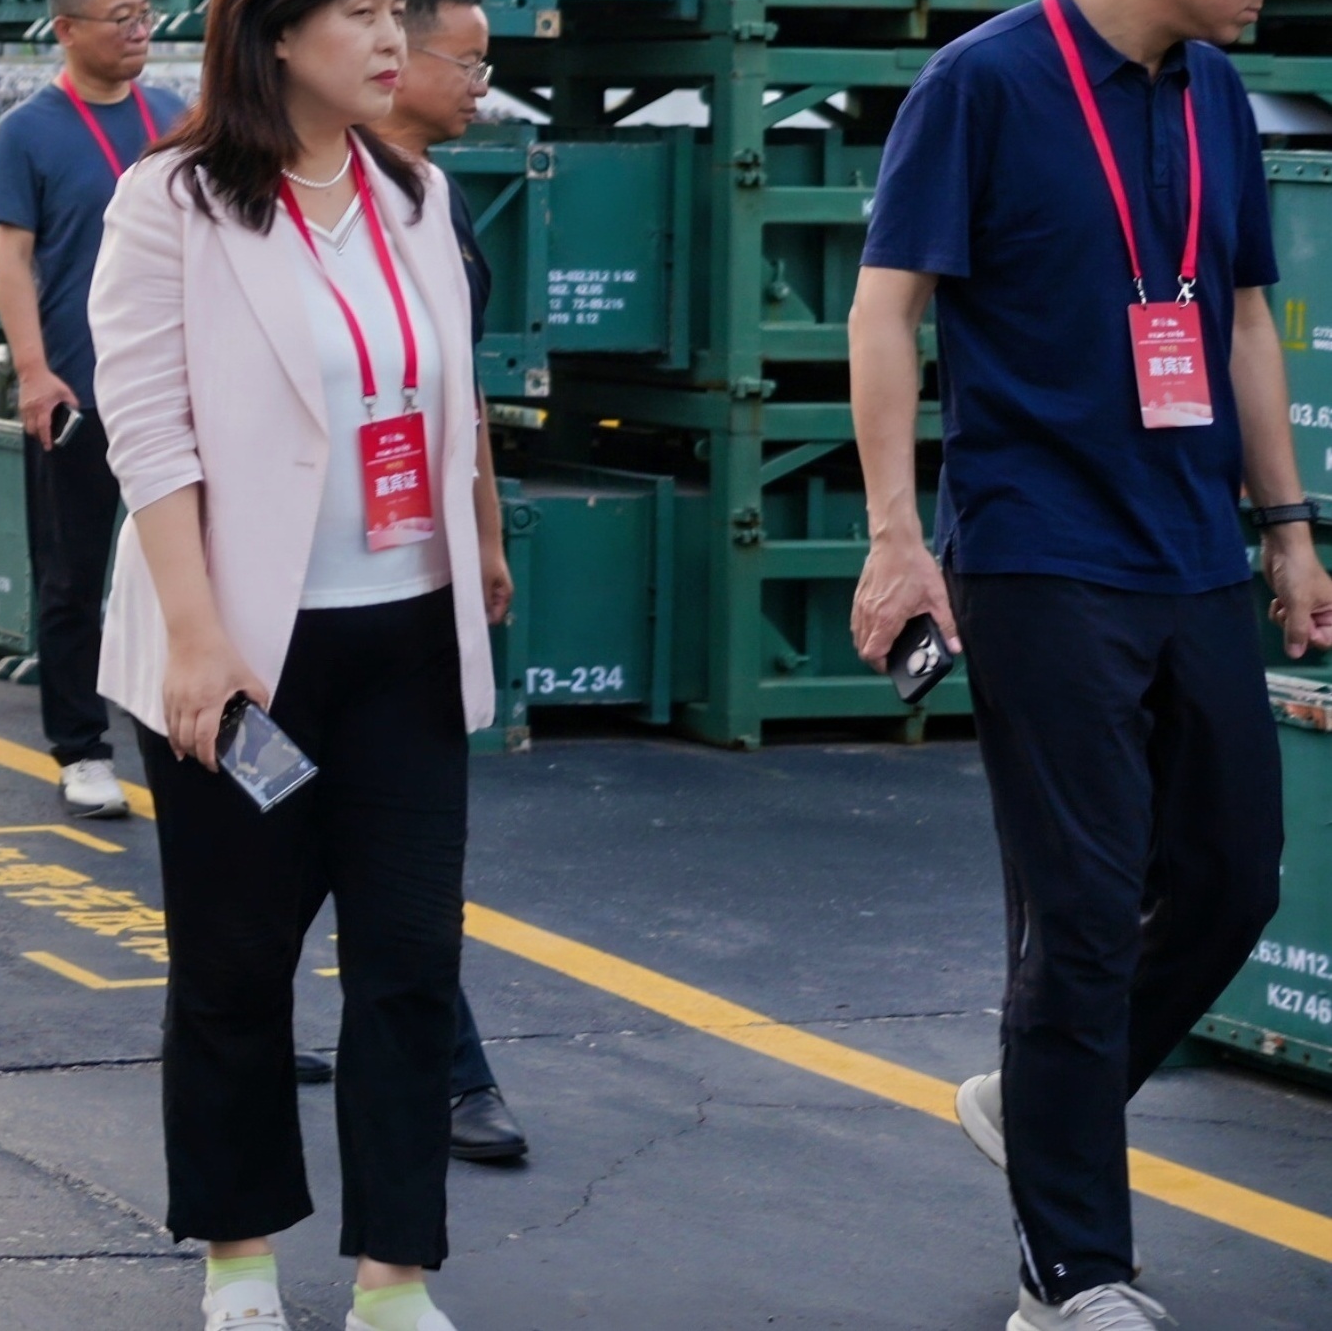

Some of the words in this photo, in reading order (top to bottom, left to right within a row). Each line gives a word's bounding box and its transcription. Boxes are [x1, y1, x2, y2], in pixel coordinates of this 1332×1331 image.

[1148, 356, 1194, 377] 嘉宾证
[375, 469, 418, 497] 嘉宾证
